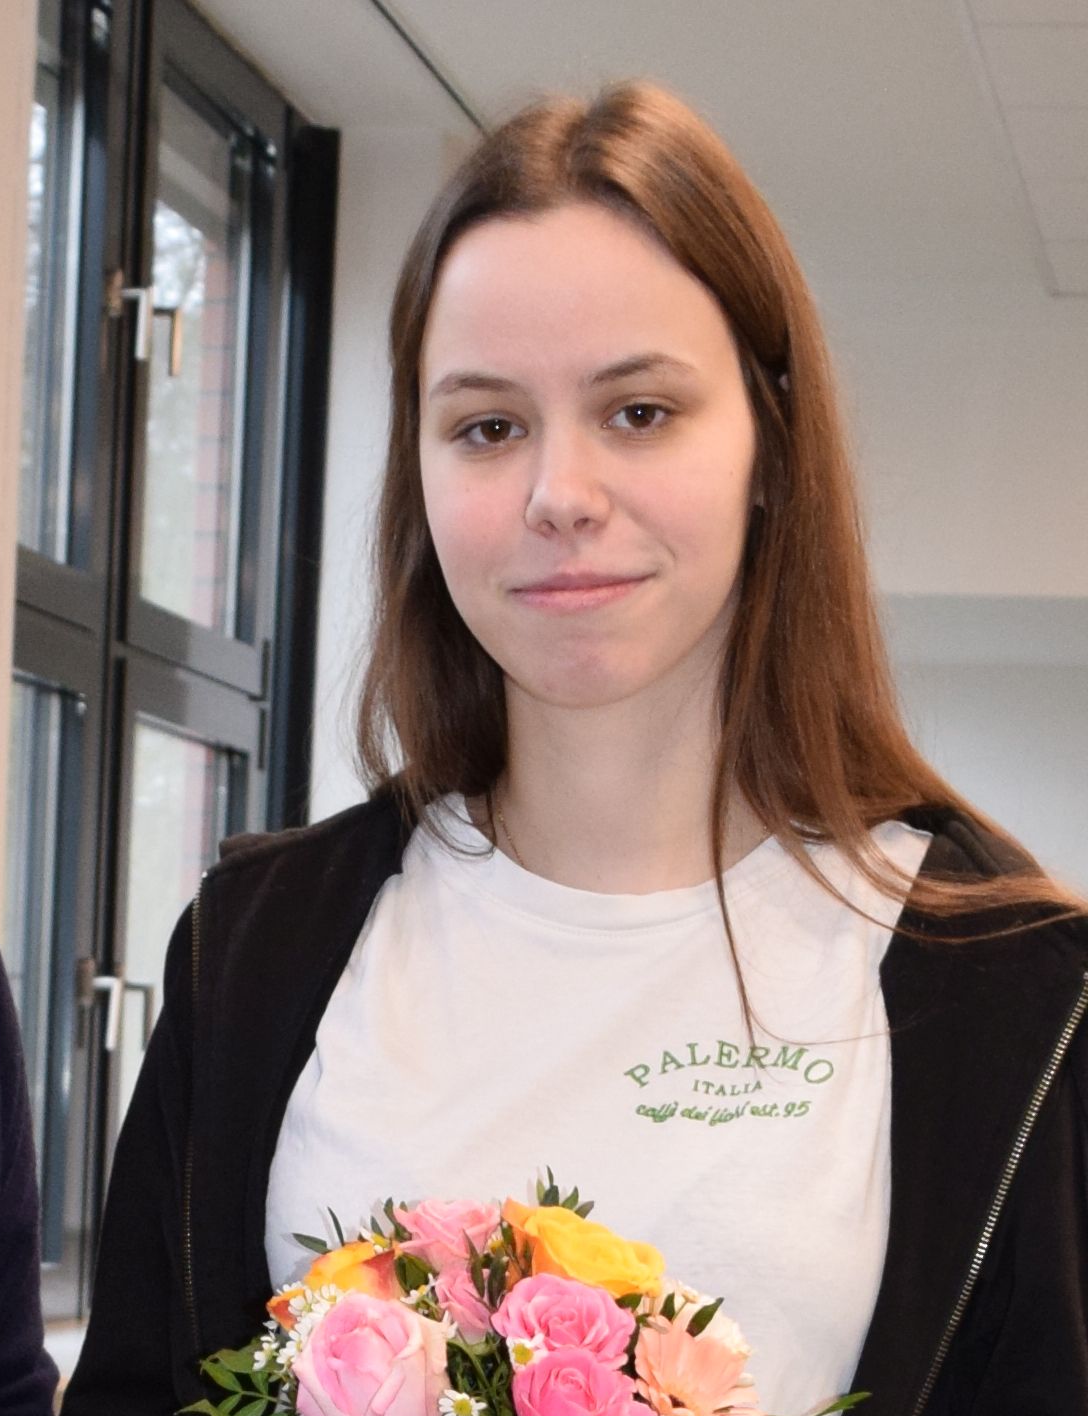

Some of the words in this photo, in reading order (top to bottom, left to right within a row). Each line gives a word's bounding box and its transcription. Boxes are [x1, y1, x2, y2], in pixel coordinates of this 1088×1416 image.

[624, 1041, 834, 1088] PALERMO
[693, 1080, 762, 1096] ITALIA
[783, 1101, 811, 1118] 95
